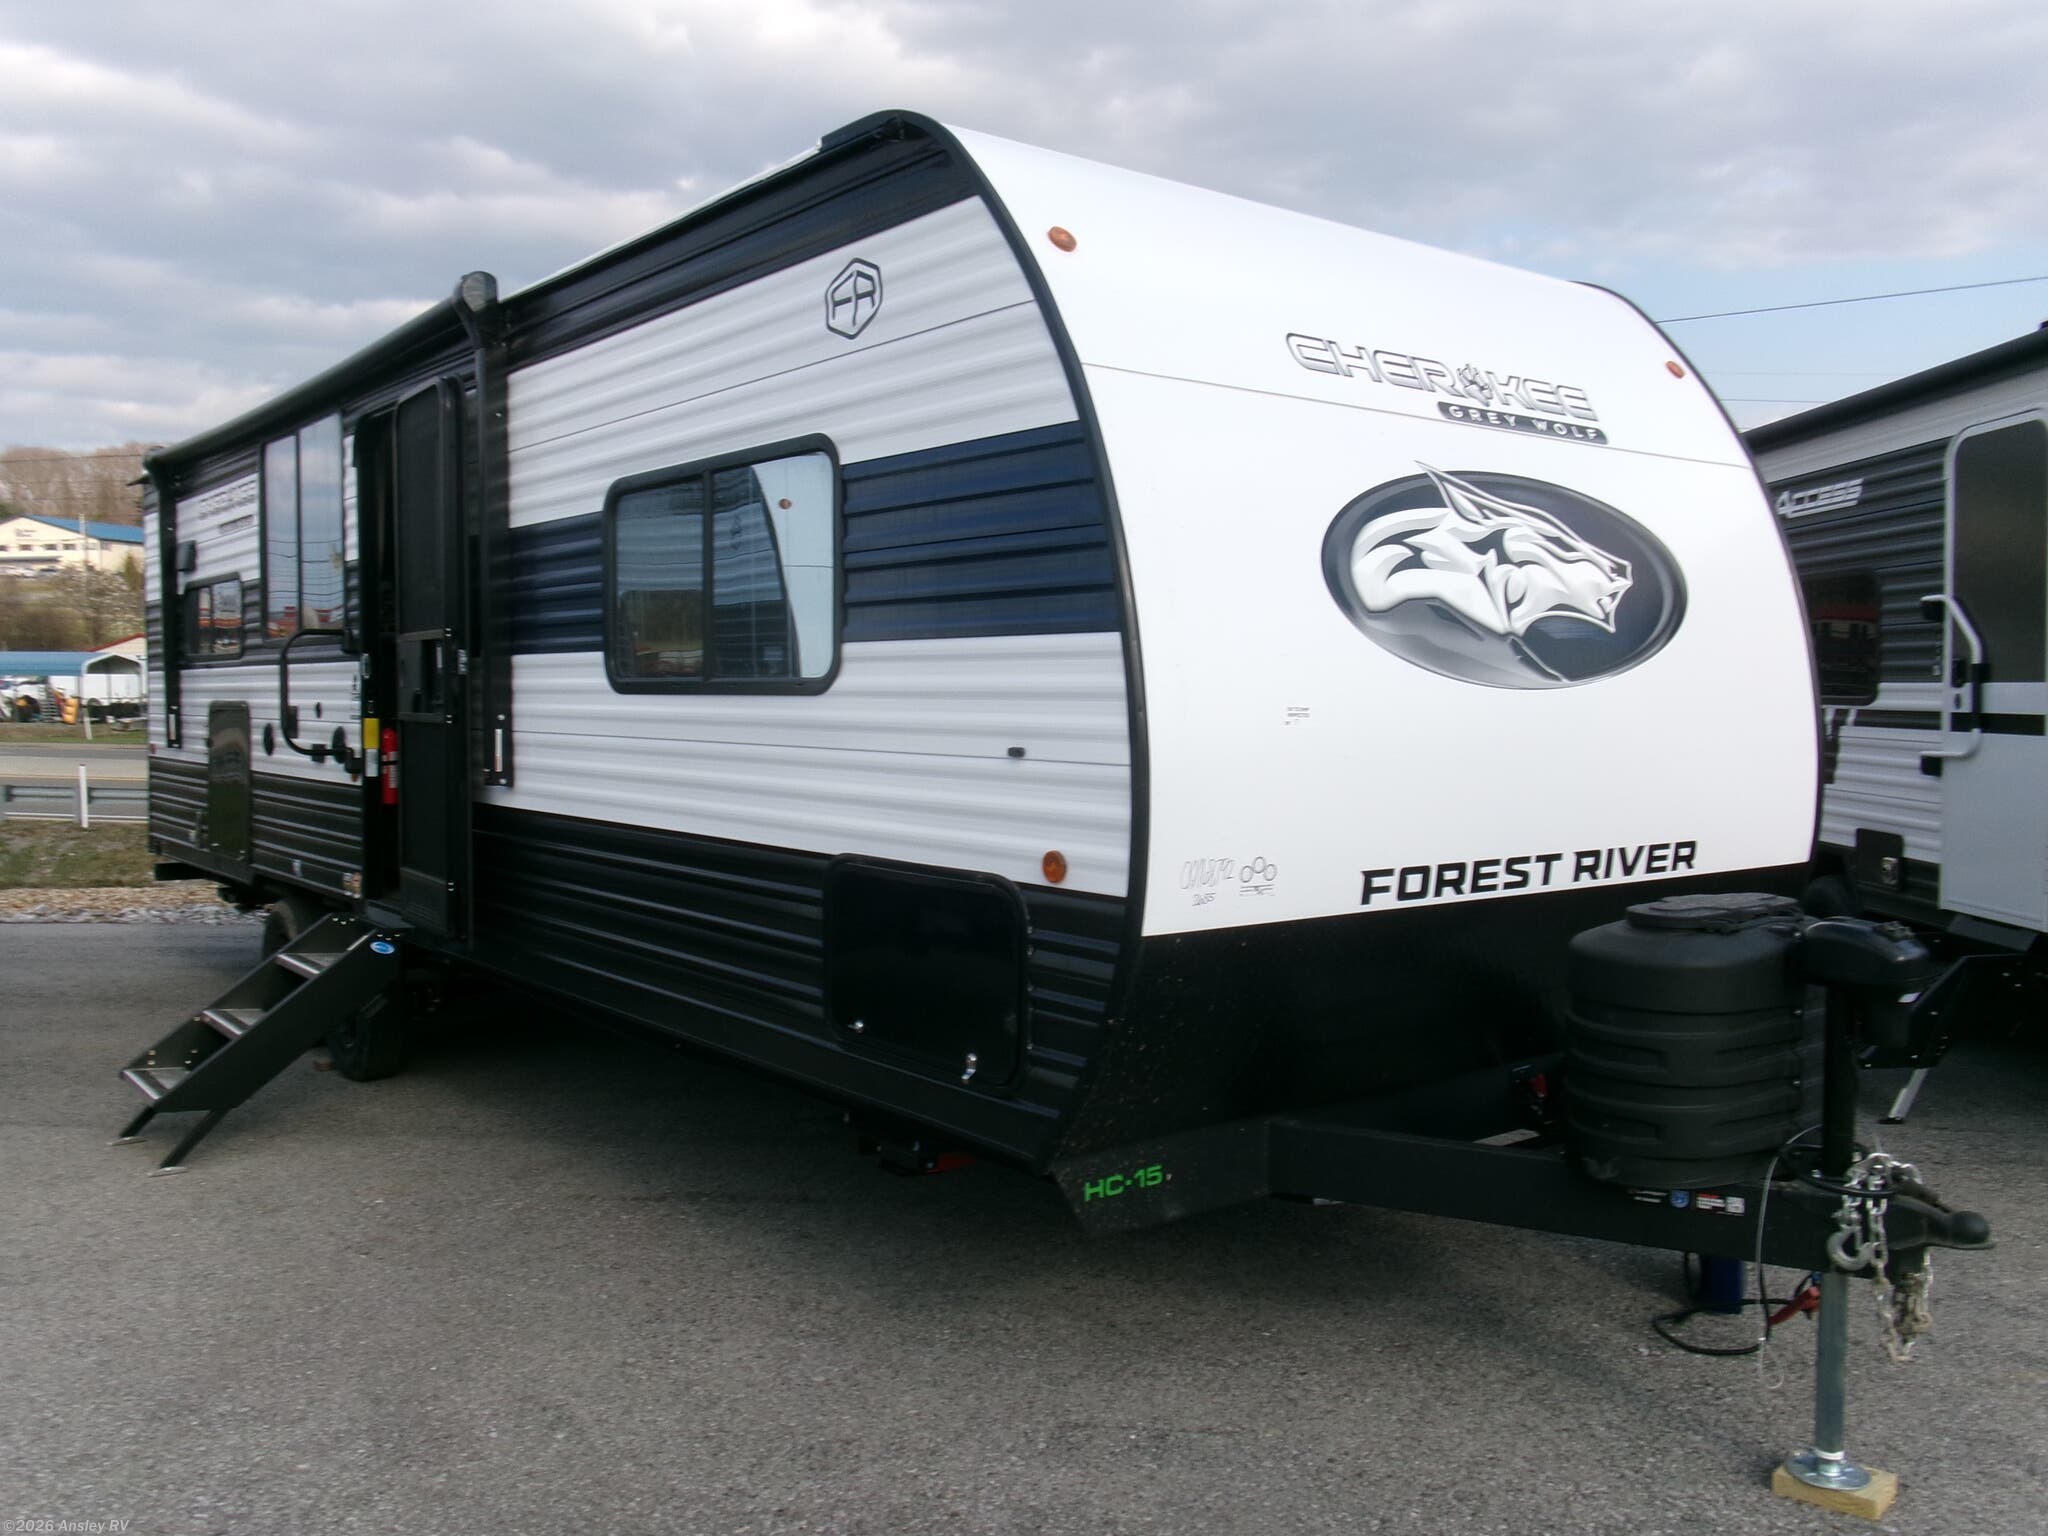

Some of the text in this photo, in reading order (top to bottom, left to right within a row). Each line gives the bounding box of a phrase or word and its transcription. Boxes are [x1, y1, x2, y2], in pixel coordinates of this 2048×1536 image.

[1448, 405, 1598, 440] GREY WOLF
[1360, 840, 1697, 905] FOREST RIVER
